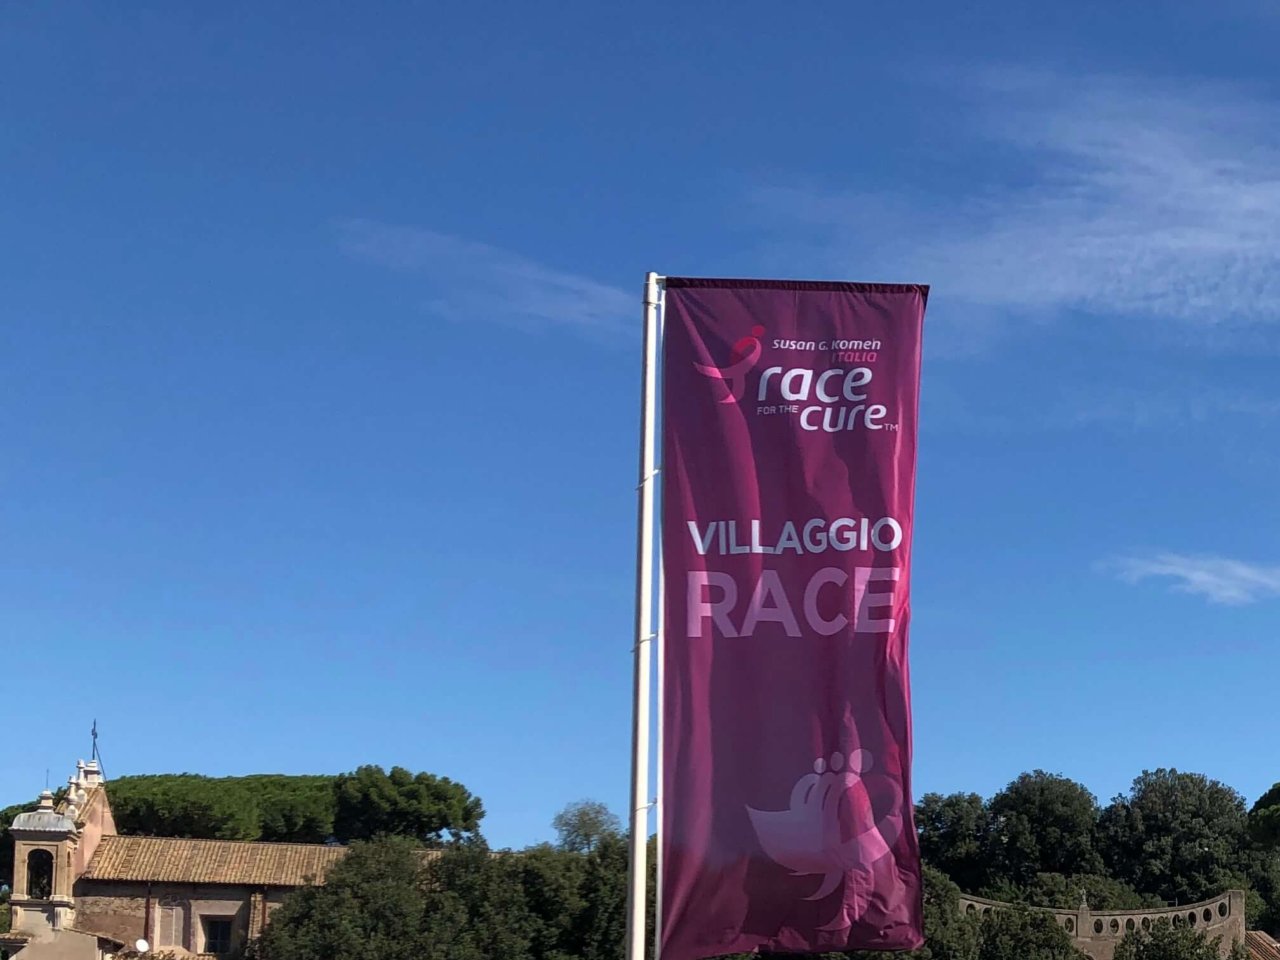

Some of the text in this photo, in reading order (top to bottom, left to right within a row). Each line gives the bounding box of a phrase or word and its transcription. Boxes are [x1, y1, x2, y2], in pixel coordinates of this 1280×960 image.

[772, 339, 815, 350] susan
[757, 366, 873, 404] race
[757, 405, 776, 415] FOR
[778, 404, 799, 414] THE
[800, 404, 888, 433] cure
[687, 516, 903, 556] VILLAGGIO
[686, 566, 900, 638] RACE
